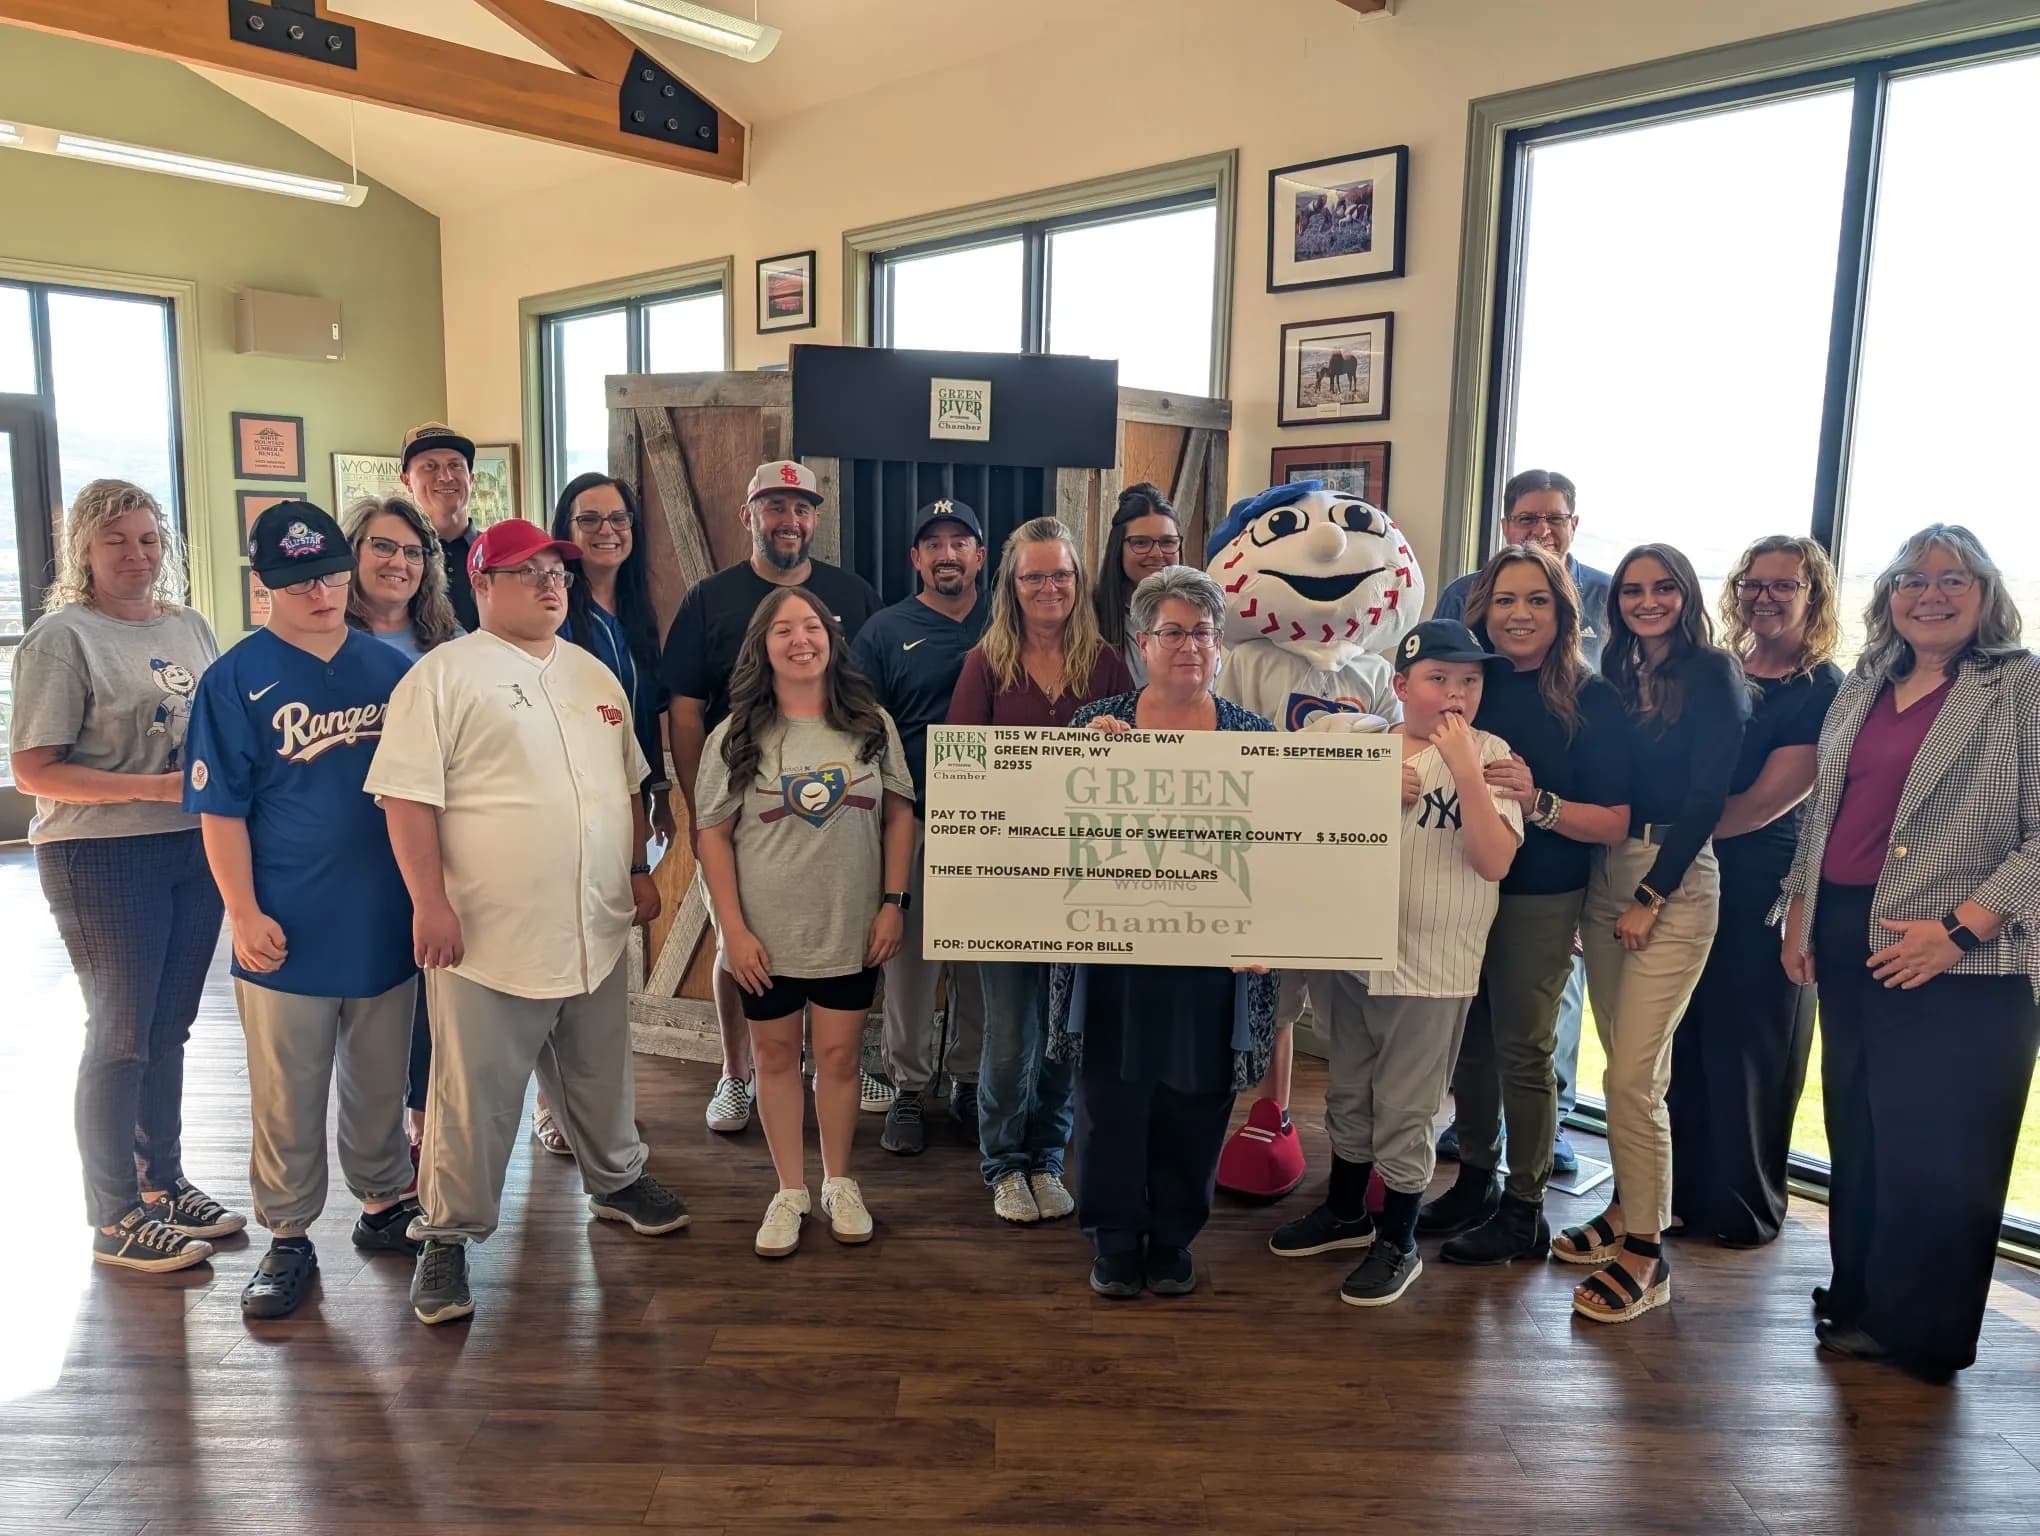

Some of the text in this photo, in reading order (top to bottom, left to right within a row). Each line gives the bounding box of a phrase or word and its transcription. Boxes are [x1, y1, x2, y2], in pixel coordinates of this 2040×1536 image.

[938, 388, 982, 400] GREEN
[938, 399, 982, 423] RIVER
[938, 422, 981, 431] Chamber
[1405, 634, 1421, 659] 9
[596, 704, 623, 723] Twins
[934, 731, 987, 743] GREEN
[994, 730, 1184, 744] 1155 W FLAMING GORGE WAY
[933, 744, 987, 770] RIVER
[994, 746, 1111, 757] GREEN RIVER, WY
[1241, 746, 1279, 756] DATE:
[1283, 747, 1363, 758] SEPTEMBER
[994, 760, 1032, 770] 82935
[934, 772, 986, 780] Chamber
[1065, 766, 1254, 807] GREEN
[931, 810, 1006, 821] PAY TO THE
[930, 825, 976, 835] ORDER
[980, 825, 1001, 836] OF:
[1008, 826, 1066, 837] MIRACLE
[1069, 827, 1121, 838] LEAGUE
[1126, 828, 1144, 838] OF
[1147, 829, 1241, 840] SWEETWATER
[1246, 831, 1302, 842] COUNTY
[1329, 833, 1388, 844] 3,500.00
[1064, 812, 1252, 904] RIVER
[929, 865, 1218, 880] THREE THOUSAND FIVE HUNDRED DOLLARS
[1114, 880, 1198, 891] WYOMING
[1066, 908, 1252, 935] Chamber
[933, 939, 1134, 952] FOR: DUCKORATING FOR BILLS
